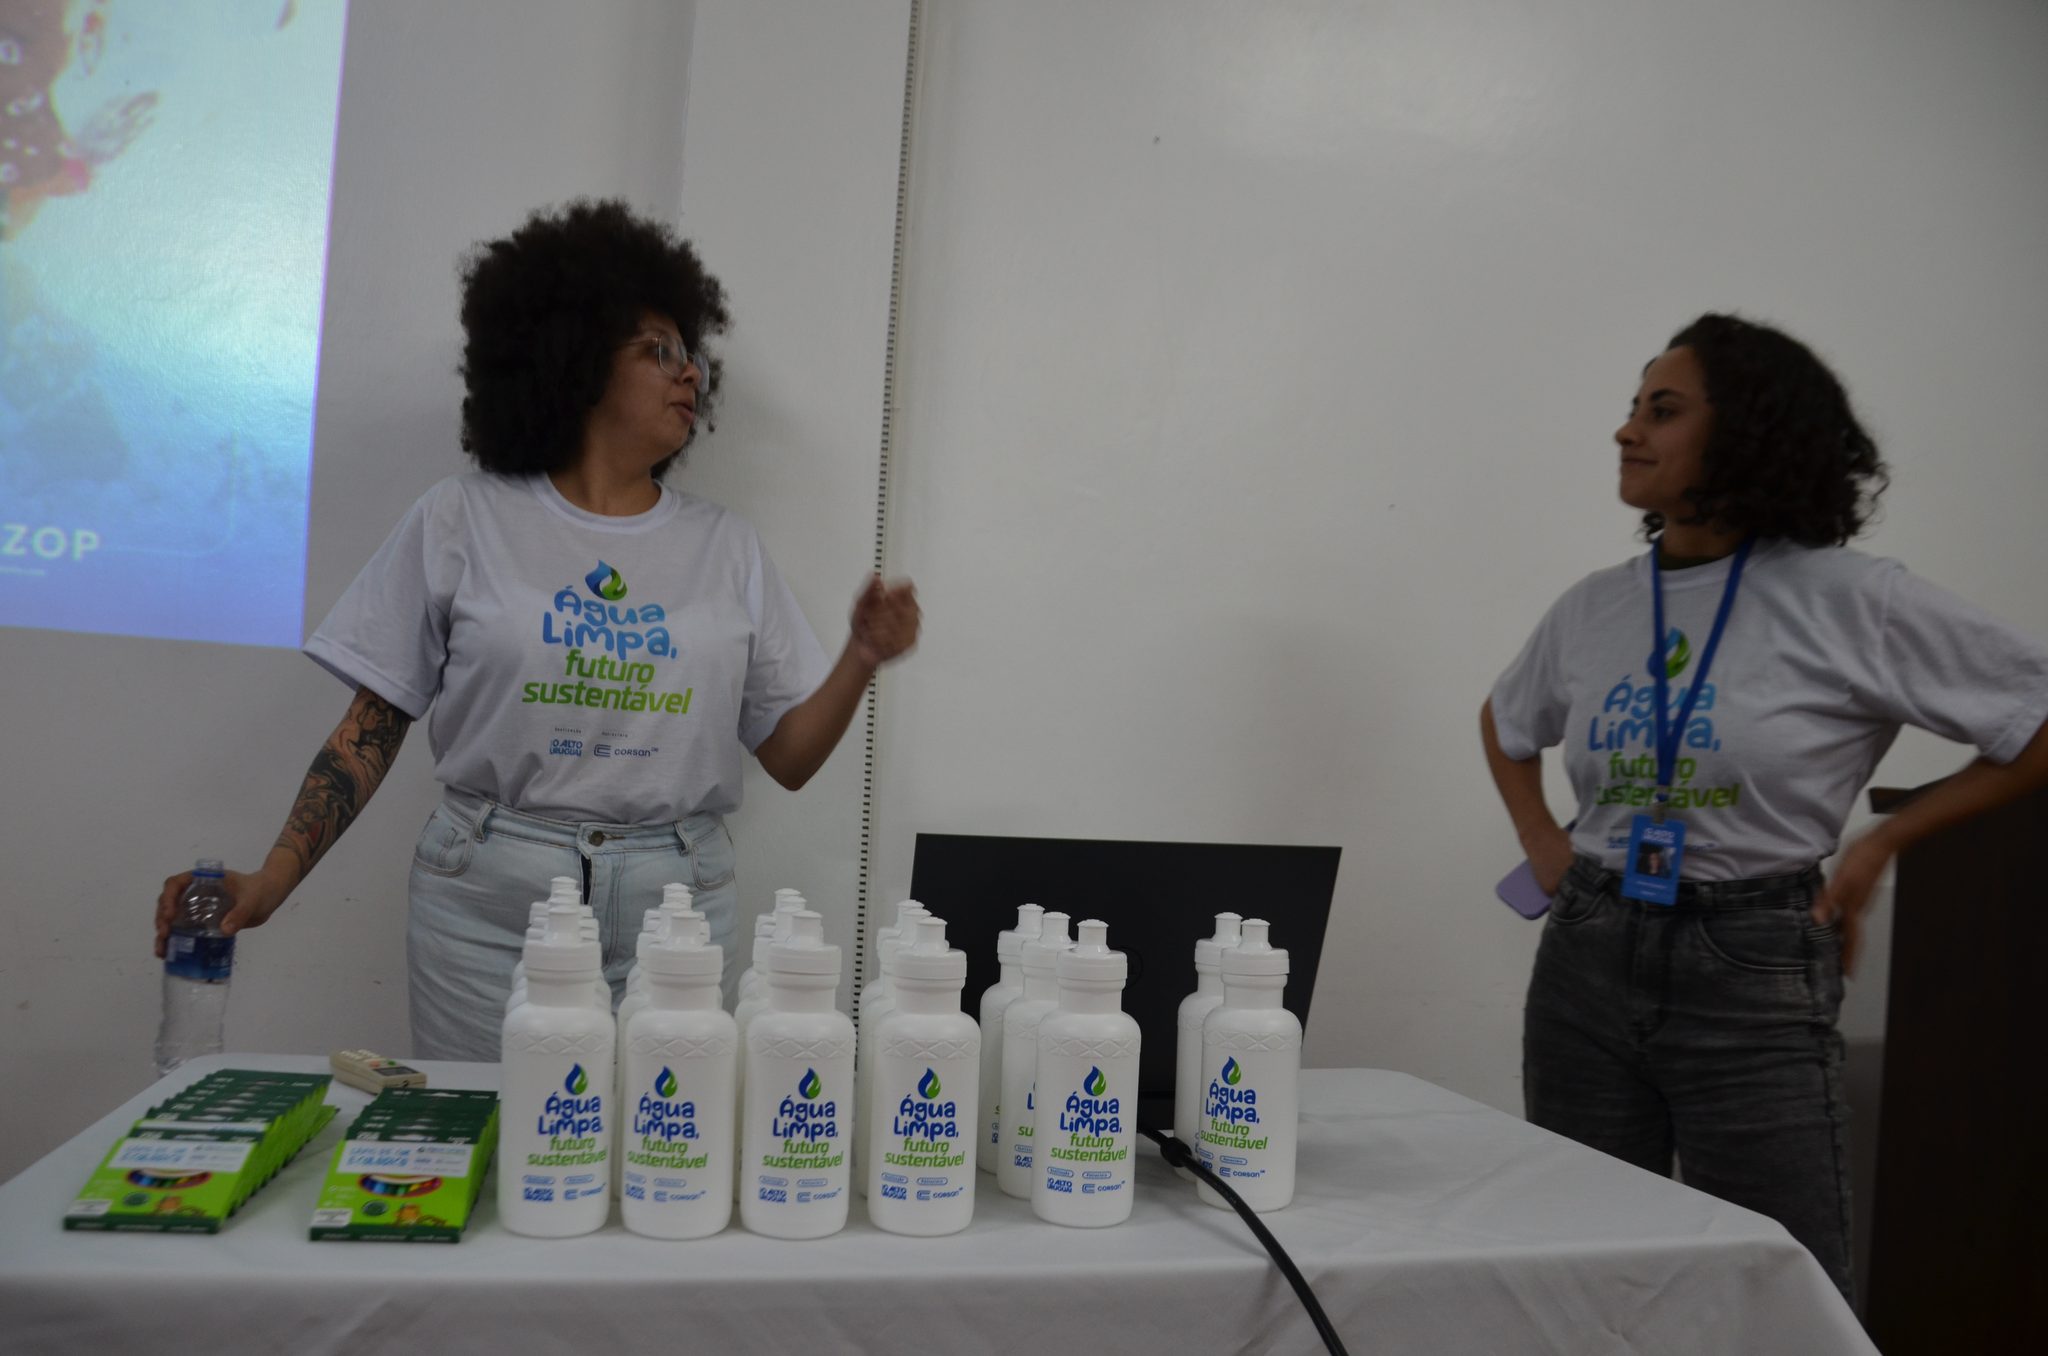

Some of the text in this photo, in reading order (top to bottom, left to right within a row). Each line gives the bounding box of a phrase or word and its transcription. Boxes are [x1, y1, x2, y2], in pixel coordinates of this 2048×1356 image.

[554, 585, 665, 627] Água
[542, 611, 678, 661] Limpa,
[565, 649, 656, 684] futuro
[522, 680, 693, 715] sustentável
[1588, 716, 1721, 751] Lima,
[1608, 752, 1697, 780] futuo
[1066, 1091, 1120, 1117] Água
[1209, 1078, 1256, 1105] Água
[545, 1091, 601, 1120] Água
[639, 1091, 695, 1121] Água
[779, 1094, 836, 1122] Água
[899, 1093, 956, 1122] Água
[1205, 1097, 1260, 1125] Limpa,
[634, 1115, 700, 1142] Limpa,
[772, 1117, 839, 1142] Limpa,
[893, 1116, 959, 1142] Limpa,
[1060, 1112, 1122, 1138] Limpa,
[1211, 1118, 1250, 1136] futuro
[549, 1135, 596, 1152] futuro
[642, 1135, 688, 1155] futuro
[783, 1138, 829, 1154] futuro
[903, 1137, 949, 1154] futuro
[1069, 1133, 1114, 1150] futuro
[1200, 1129, 1268, 1150] sustentável
[627, 1151, 708, 1169] sustentável
[761, 1150, 844, 1170] sustentável
[884, 1150, 965, 1169] sustentável
[1050, 1145, 1128, 1164] sustentável
